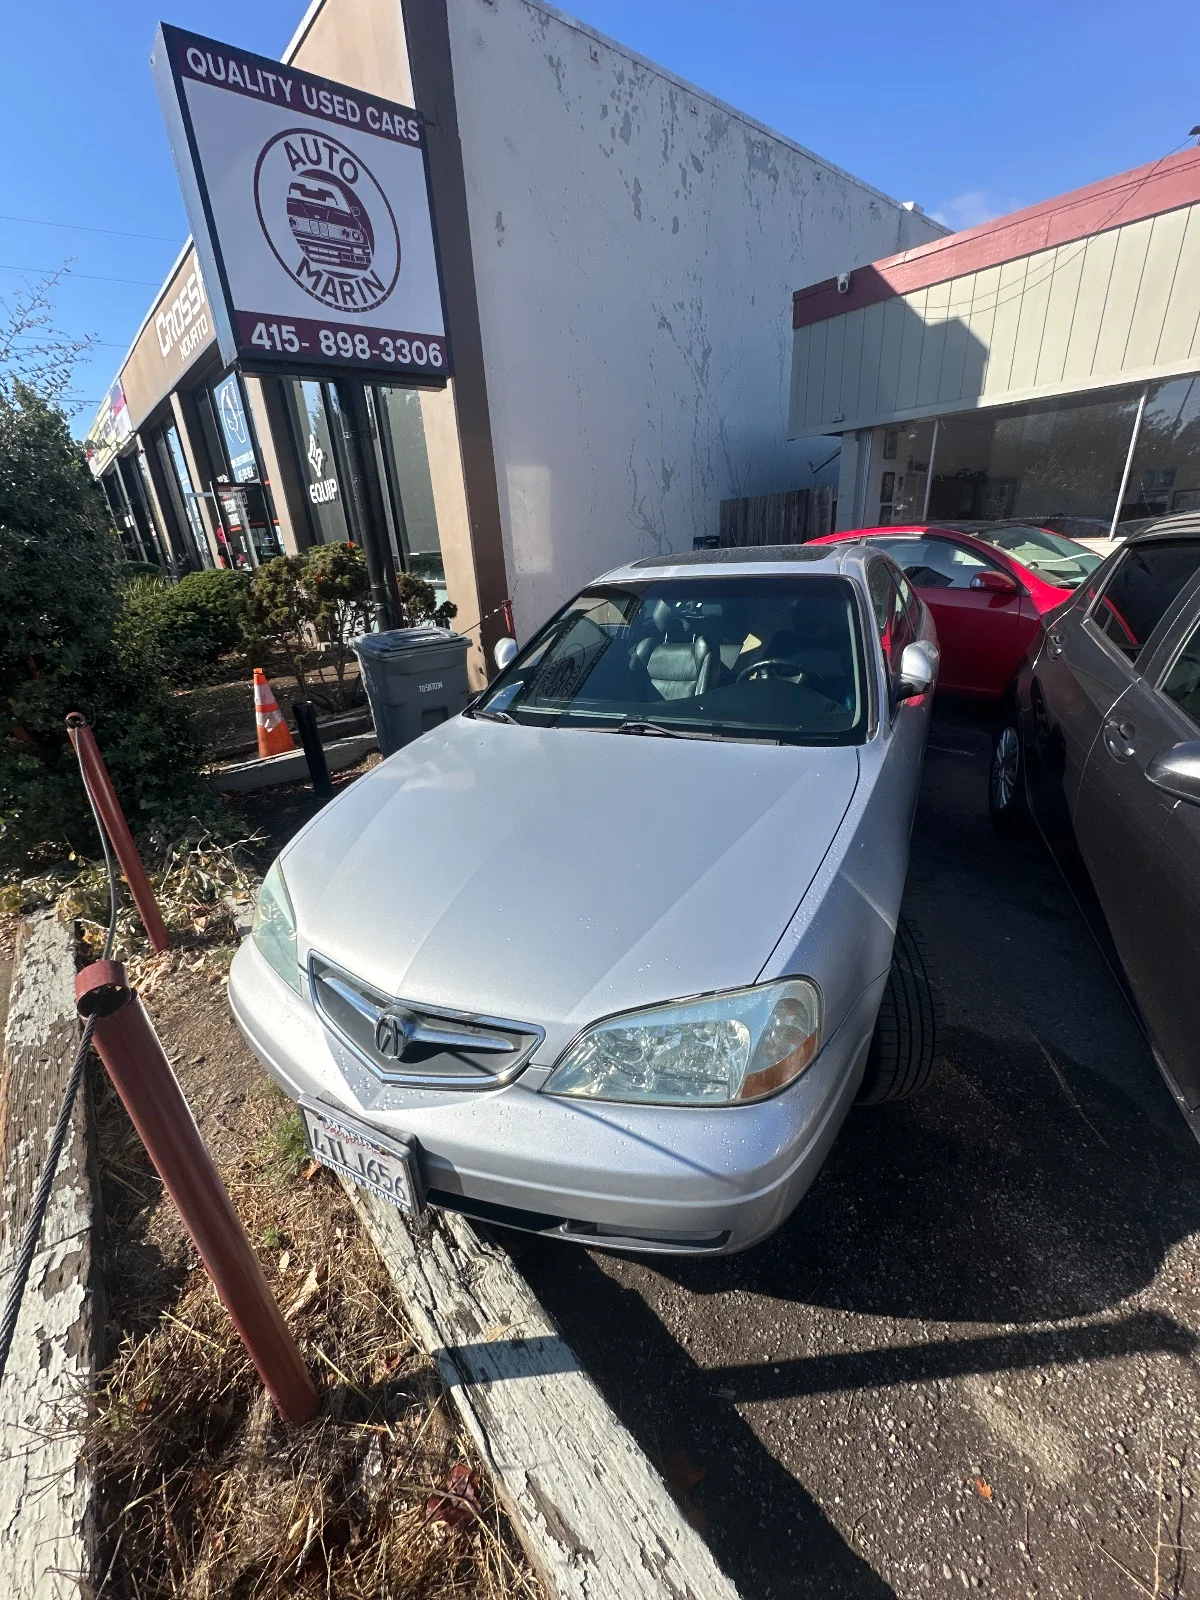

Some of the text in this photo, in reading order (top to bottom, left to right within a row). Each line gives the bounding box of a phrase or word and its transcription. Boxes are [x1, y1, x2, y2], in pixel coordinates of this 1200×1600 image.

[186, 47, 420, 142] QUALITY USED CARS
[284, 137, 358, 184] AUTO
[295, 256, 387, 306] MARIN
[179, 313, 208, 361] NOVATO
[251, 322, 443, 367] 415- 898-3306
[310, 478, 338, 503] EQUIP
